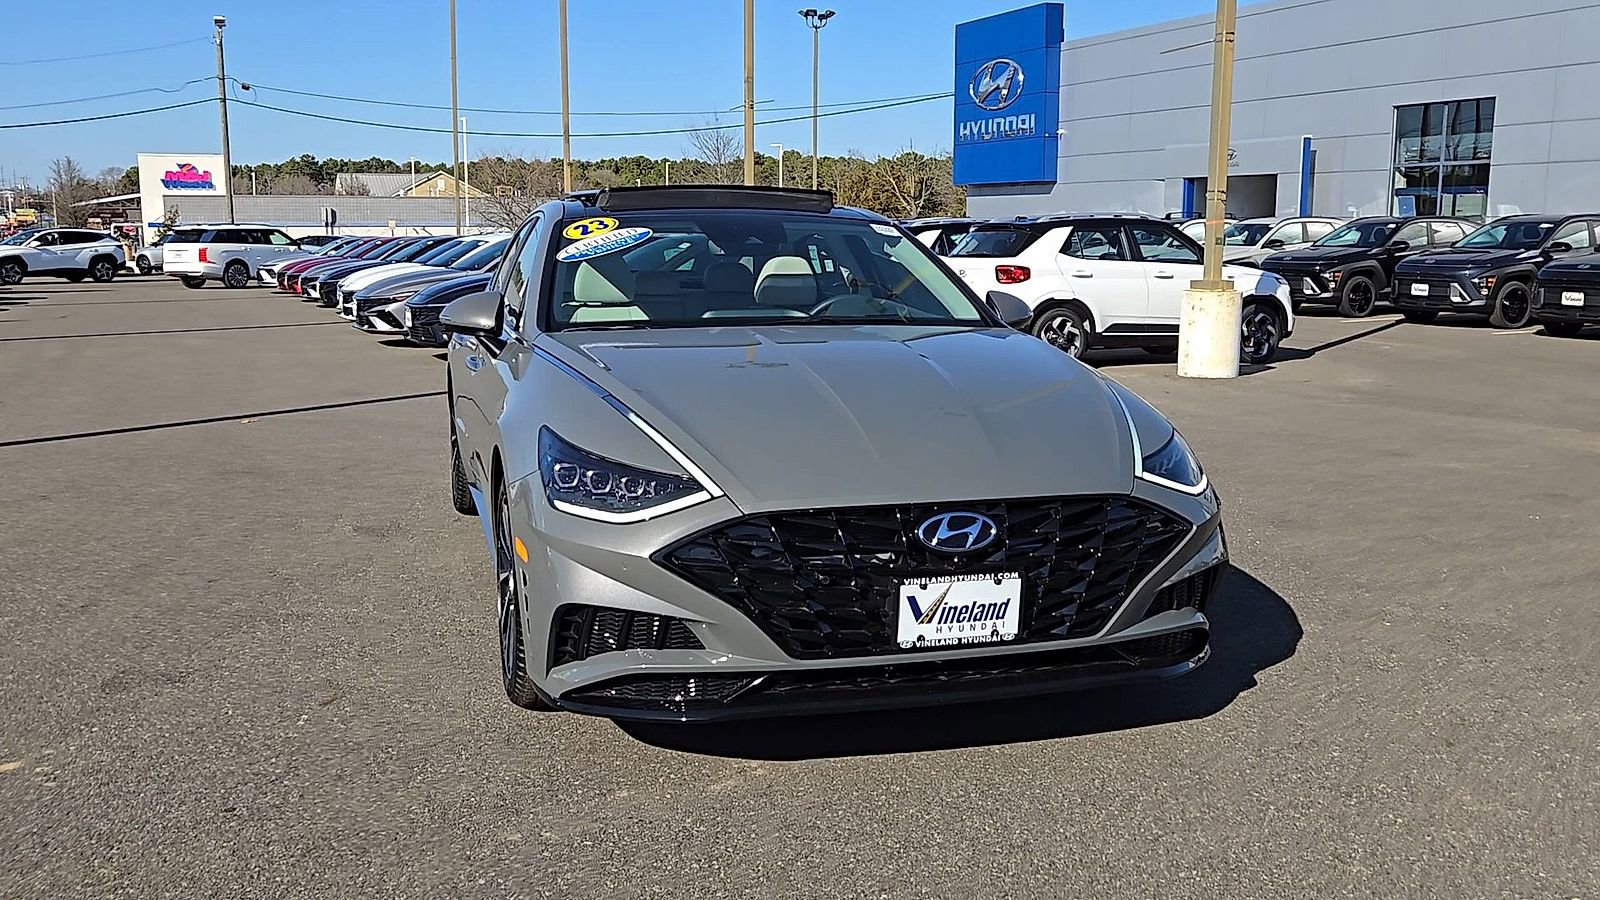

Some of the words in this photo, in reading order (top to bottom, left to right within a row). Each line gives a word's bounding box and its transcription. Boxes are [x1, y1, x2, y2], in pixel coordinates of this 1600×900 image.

[960, 113, 1035, 142] HYUNDAI
[573, 219, 610, 236] 23
[564, 228, 638, 255] CERTIFIED
[903, 571, 1019, 586] VINELANDHYUNDAI.COM
[906, 583, 1011, 625] Vineland
[935, 620, 1006, 634] HYUNDAI
[915, 637, 959, 648] VINELAND
[961, 635, 1001, 645] HYUNDAI
